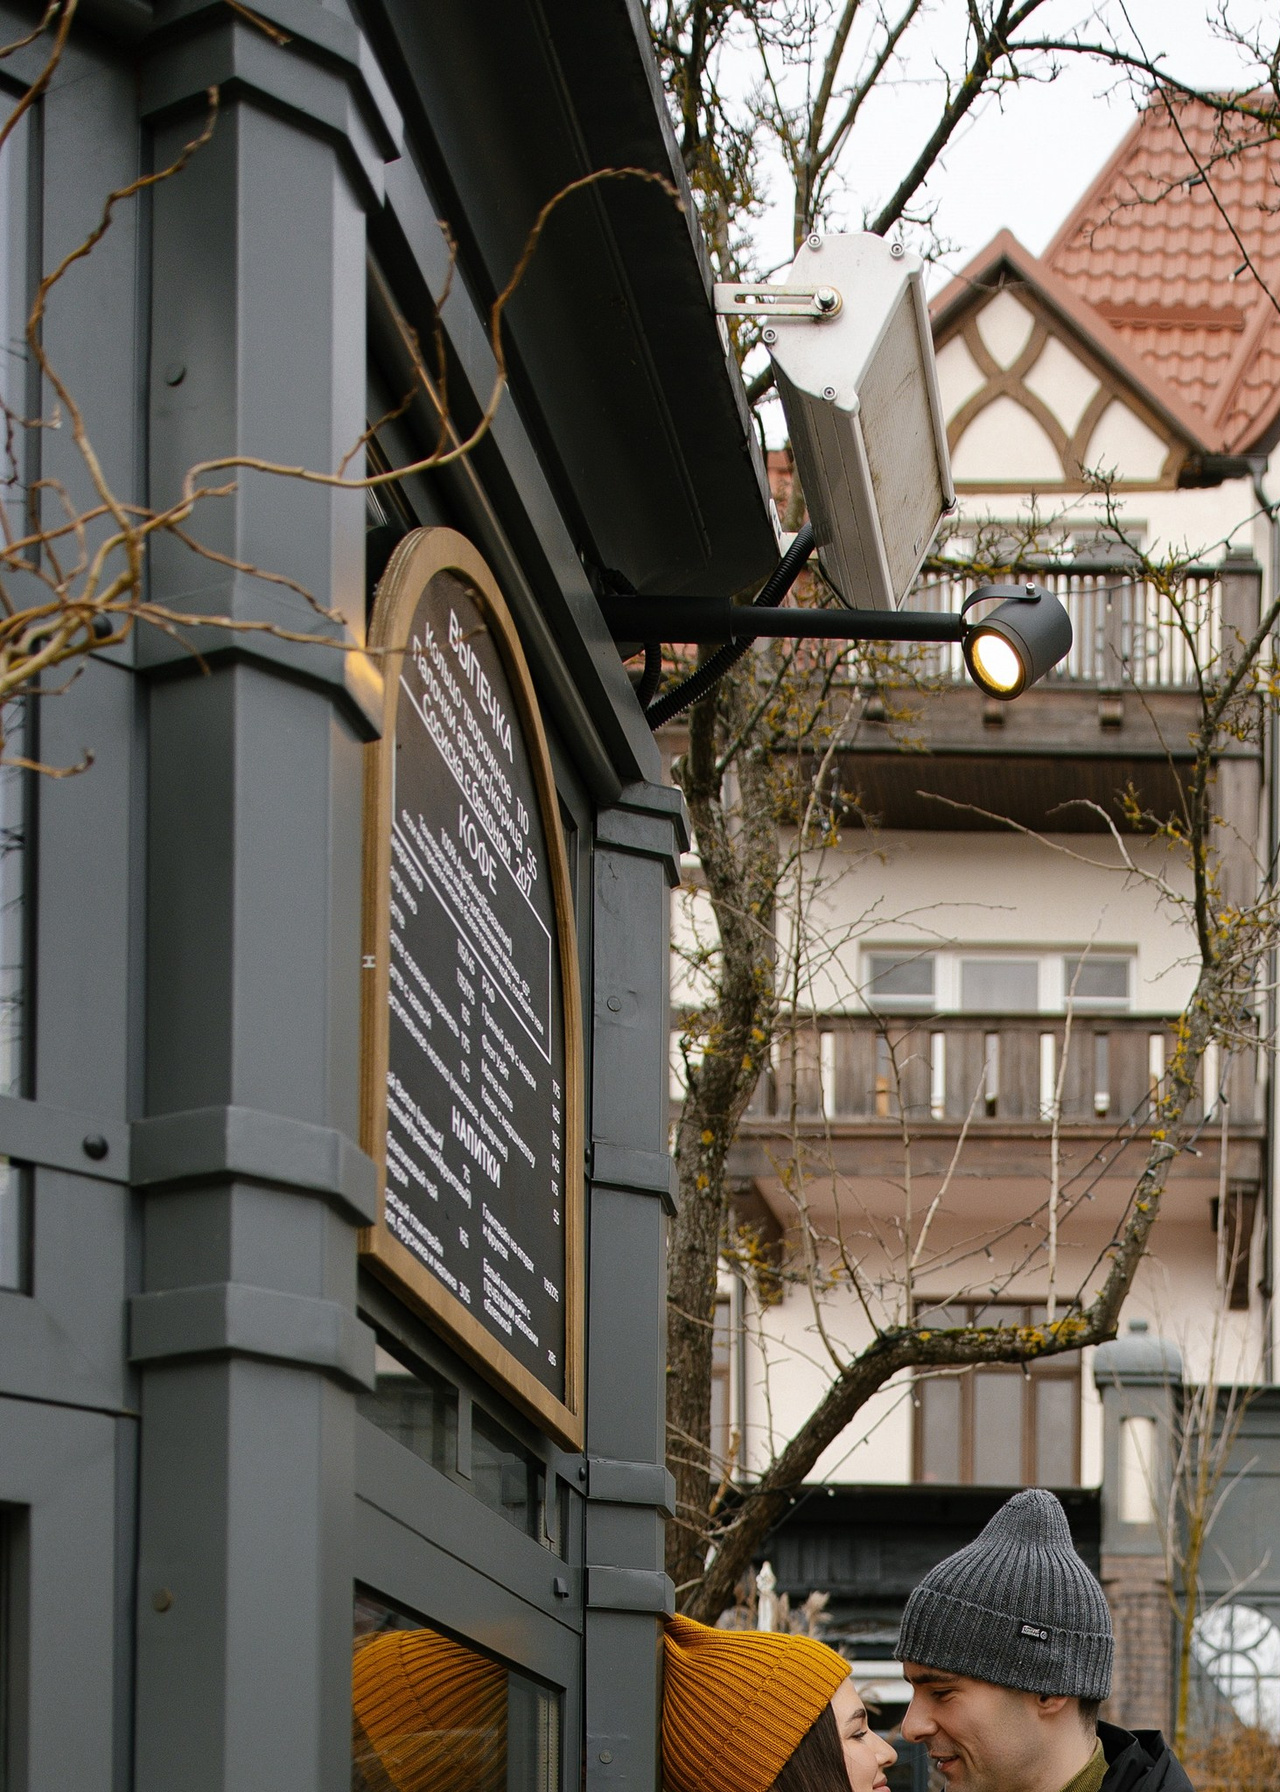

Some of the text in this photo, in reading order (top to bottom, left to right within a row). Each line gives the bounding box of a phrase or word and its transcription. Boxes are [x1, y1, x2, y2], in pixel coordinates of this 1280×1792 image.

[448, 609, 512, 763] ВЫПЕЧКА
[412, 636, 536, 880] Палочки арахис/корица 55
[425, 623, 528, 835] Кольцо творожное 110
[422, 694, 531, 897] Сосиска с беконом 207
[418, 814, 452, 879] Температура
[441, 828, 456, 864] 100%
[458, 805, 496, 895] КОФЕ
[389, 901, 405, 928] атте
[390, 835, 422, 891] мерикано
[481, 976, 495, 1003] РАФ
[389, 866, 417, 914] апучино
[481, 1003, 503, 1044] Пряный
[504, 1039, 514, 1062] раф
[518, 1060, 536, 1090] медом
[387, 991, 427, 1051] астительное
[427, 1045, 449, 1081] молоко
[389, 930, 404, 957] атте
[430, 990, 459, 1037] карамель
[481, 1059, 497, 1092] Матча
[497, 1086, 513, 1112] латте
[389, 964, 403, 990] атте
[481, 1085, 497, 1116] Какао
[386, 1072, 395, 1089] ай
[452, 1106, 500, 1188] НАПИТКИ
[426, 1180, 437, 1200] чай
[396, 1218, 427, 1260] брусника
[434, 1260, 457, 1290] малина
[459, 1282, 470, 1303] 305
[410, 1214, 443, 1256] глинтвейн
[482, 1203, 510, 1245] Глинтвейн
[510, 1239, 517, 1253] на
[517, 1247, 534, 1273] ягодах
[486, 1228, 508, 1260] фруктах
[483, 1258, 500, 1287] Белый
[500, 1281, 526, 1315] глинтвейн
[515, 1315, 538, 1346] яблоками
